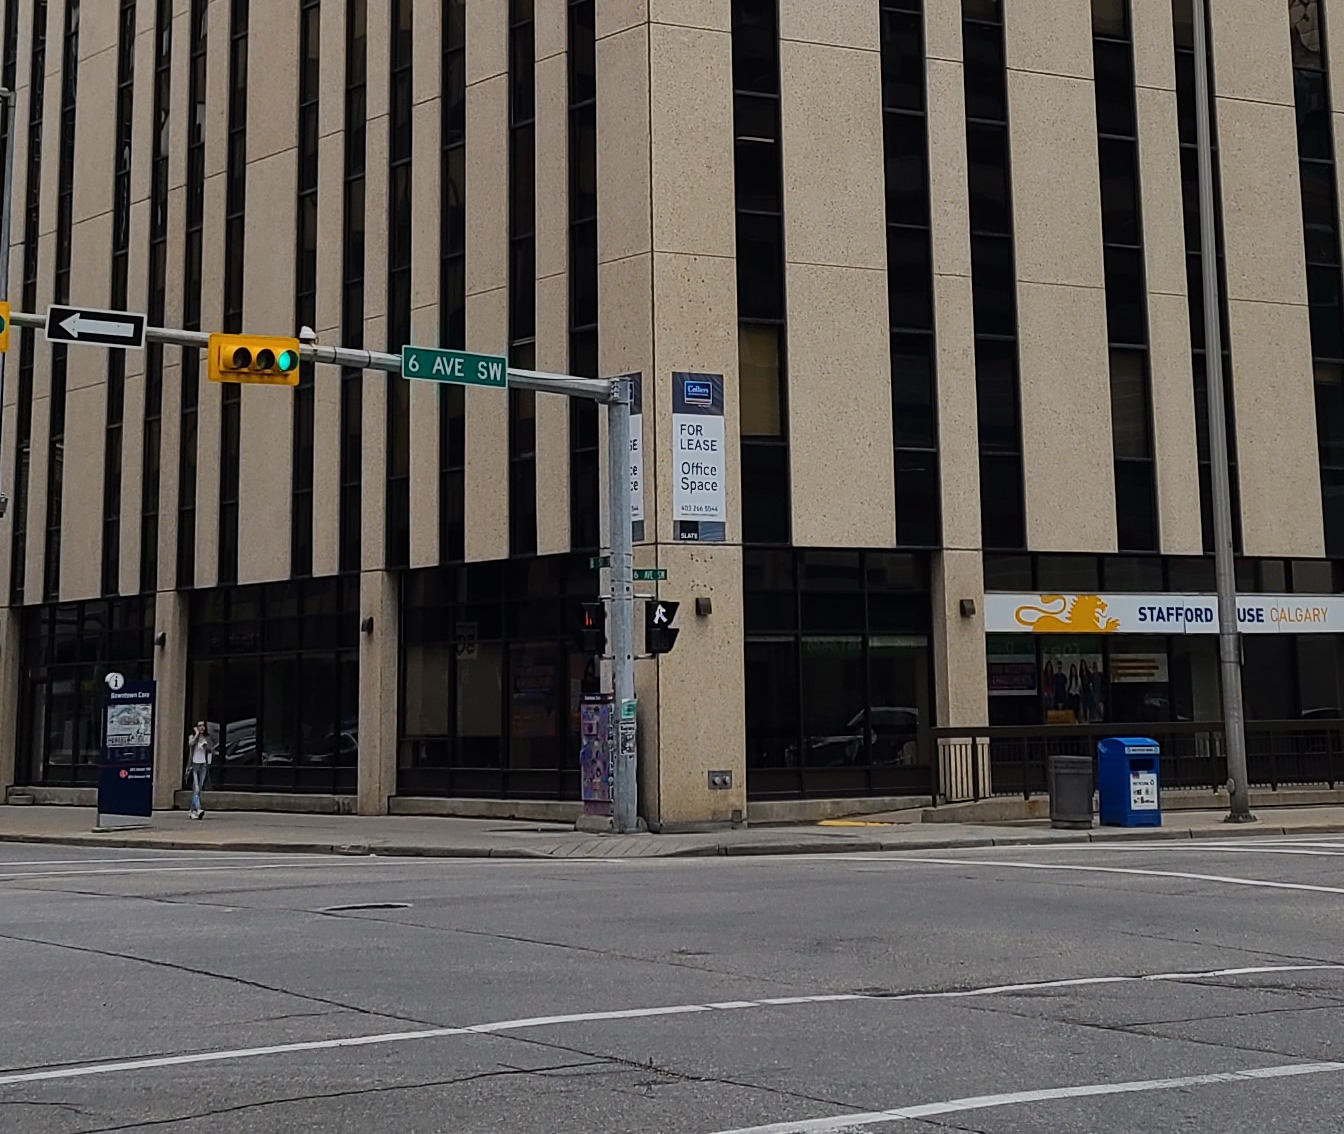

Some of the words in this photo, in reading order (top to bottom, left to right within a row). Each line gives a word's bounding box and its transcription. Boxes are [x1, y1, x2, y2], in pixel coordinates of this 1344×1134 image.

[408, 354, 419, 372] 6
[432, 356, 464, 376] AVE
[477, 361, 502, 381] SW
[680, 424, 703, 437] FOR
[680, 438, 718, 452] LEASE
[681, 461, 717, 476] Office
[681, 477, 718, 494] Space
[634, 571, 639, 579] 6
[1138, 607, 1214, 623] STAFFORD
[1237, 608, 1265, 623] USE
[1270, 607, 1328, 623] CALGARY
